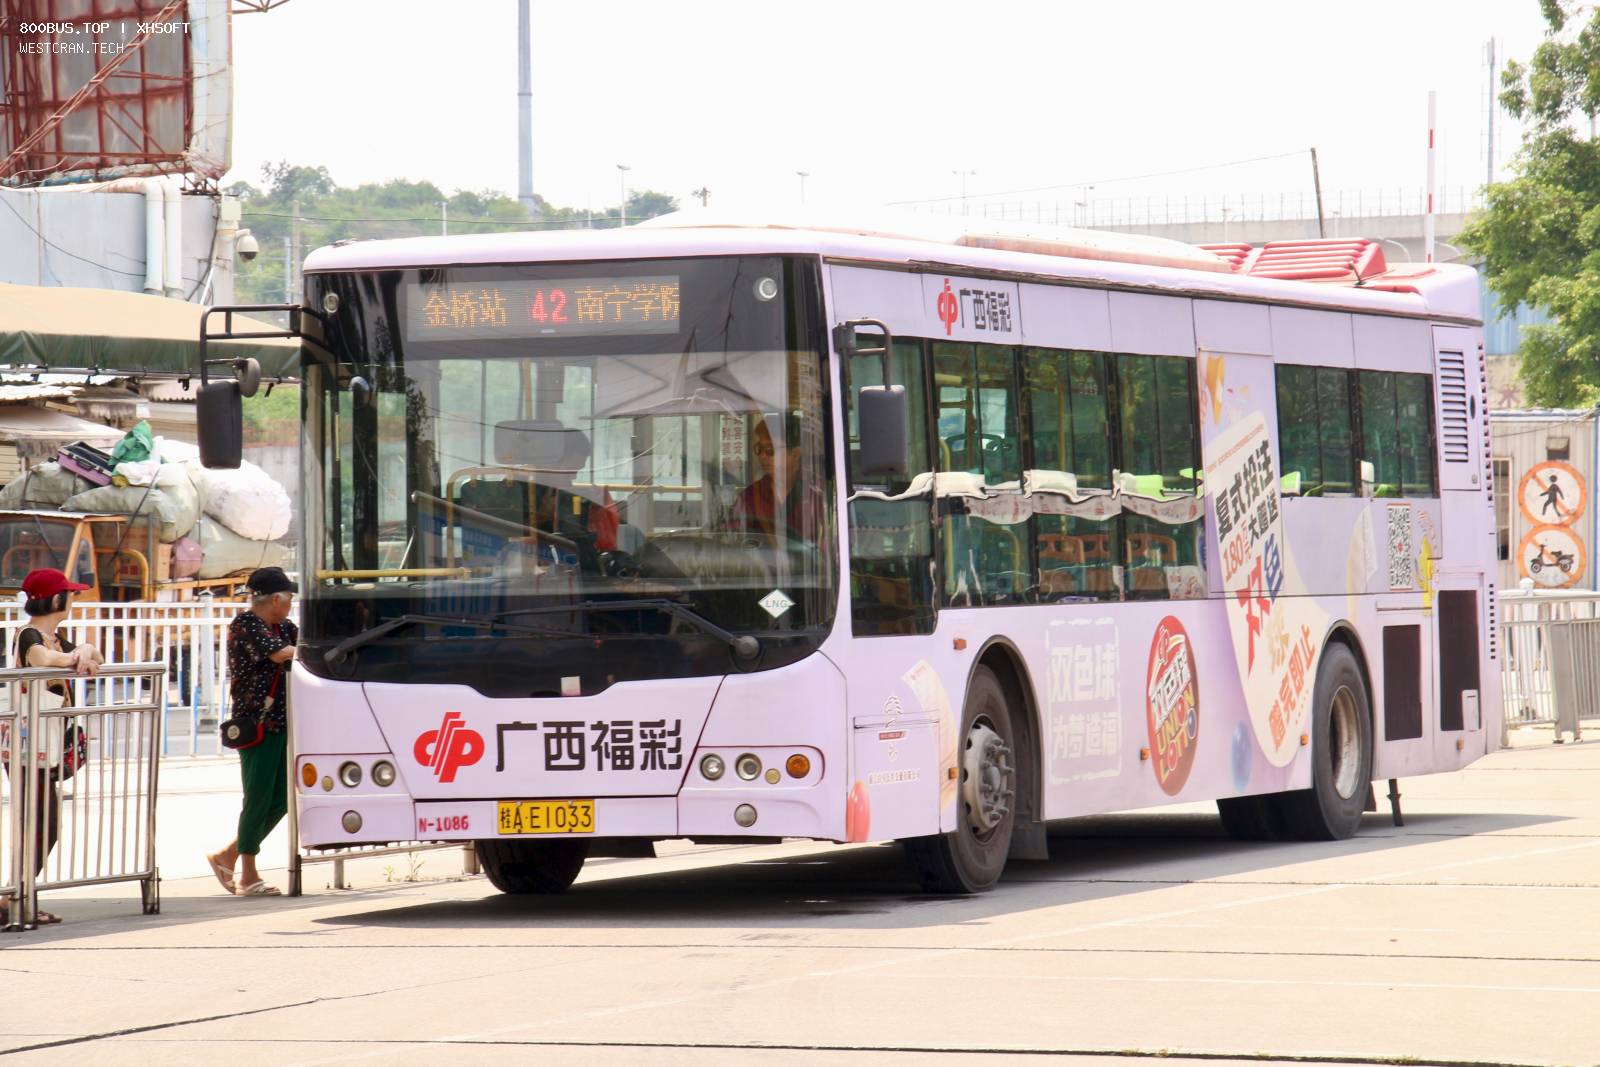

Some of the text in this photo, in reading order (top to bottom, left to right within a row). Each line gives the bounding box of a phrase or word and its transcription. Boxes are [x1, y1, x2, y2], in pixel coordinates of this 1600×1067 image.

[423, 290, 507, 328] 金桥站
[530, 289, 568, 325] 42
[959, 287, 1012, 332] 广西福彩
[1215, 439, 1274, 543] 复式投注
[765, 600, 788, 608] LNG
[495, 719, 683, 773] 广西福彩
[418, 815, 469, 832] N-1086
